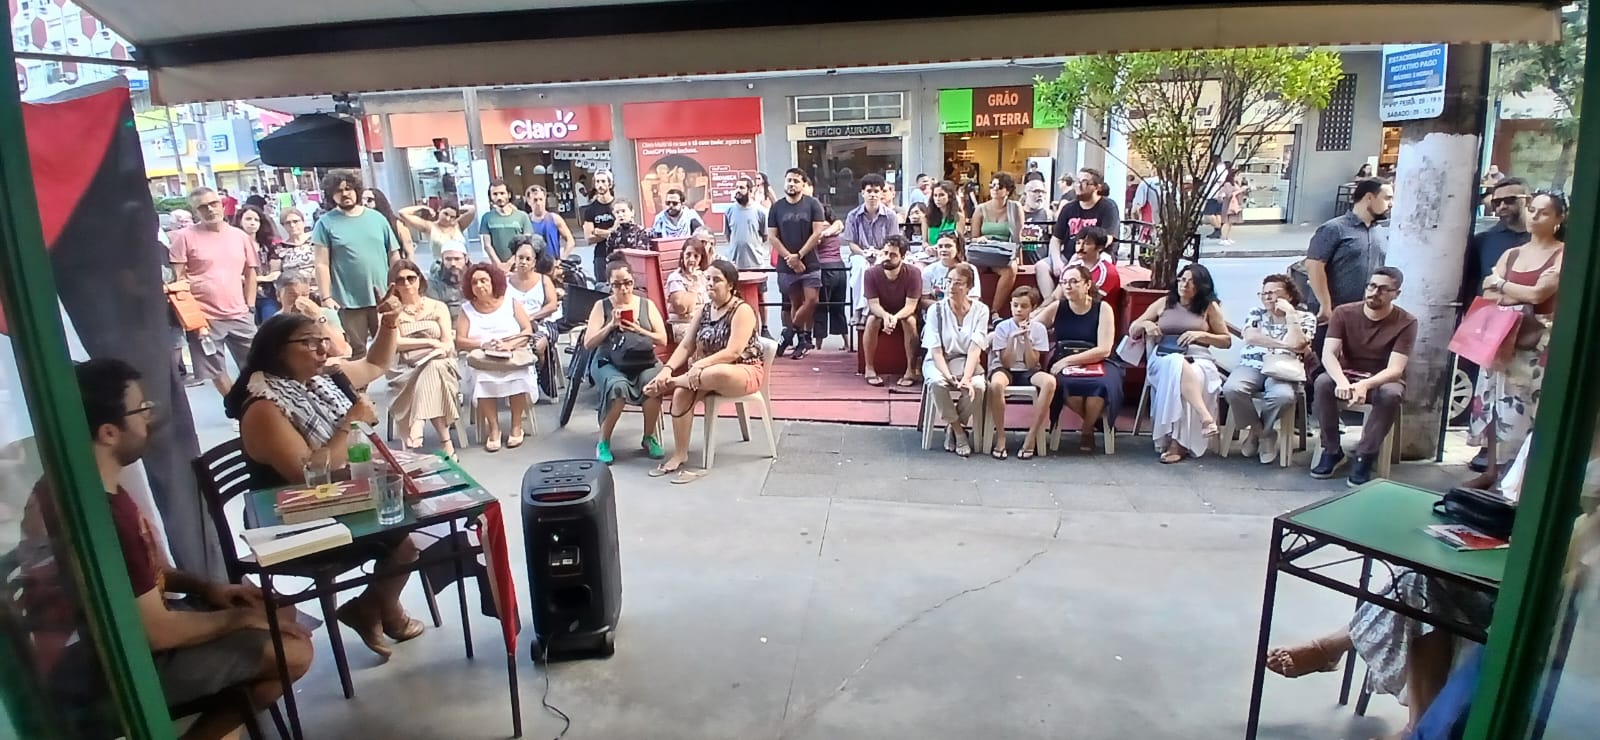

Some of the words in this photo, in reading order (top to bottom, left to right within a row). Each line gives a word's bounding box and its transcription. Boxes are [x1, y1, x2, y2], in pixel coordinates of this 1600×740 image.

[1391, 62, 1419, 72] ROTATIVO
[1420, 59, 1438, 68] PAGO
[988, 90, 1018, 106] GRÃO
[976, 114, 990, 126] DA
[992, 112, 1030, 126] TERRA
[510, 118, 568, 140] Claro
[844, 125, 882, 136] AURORA
